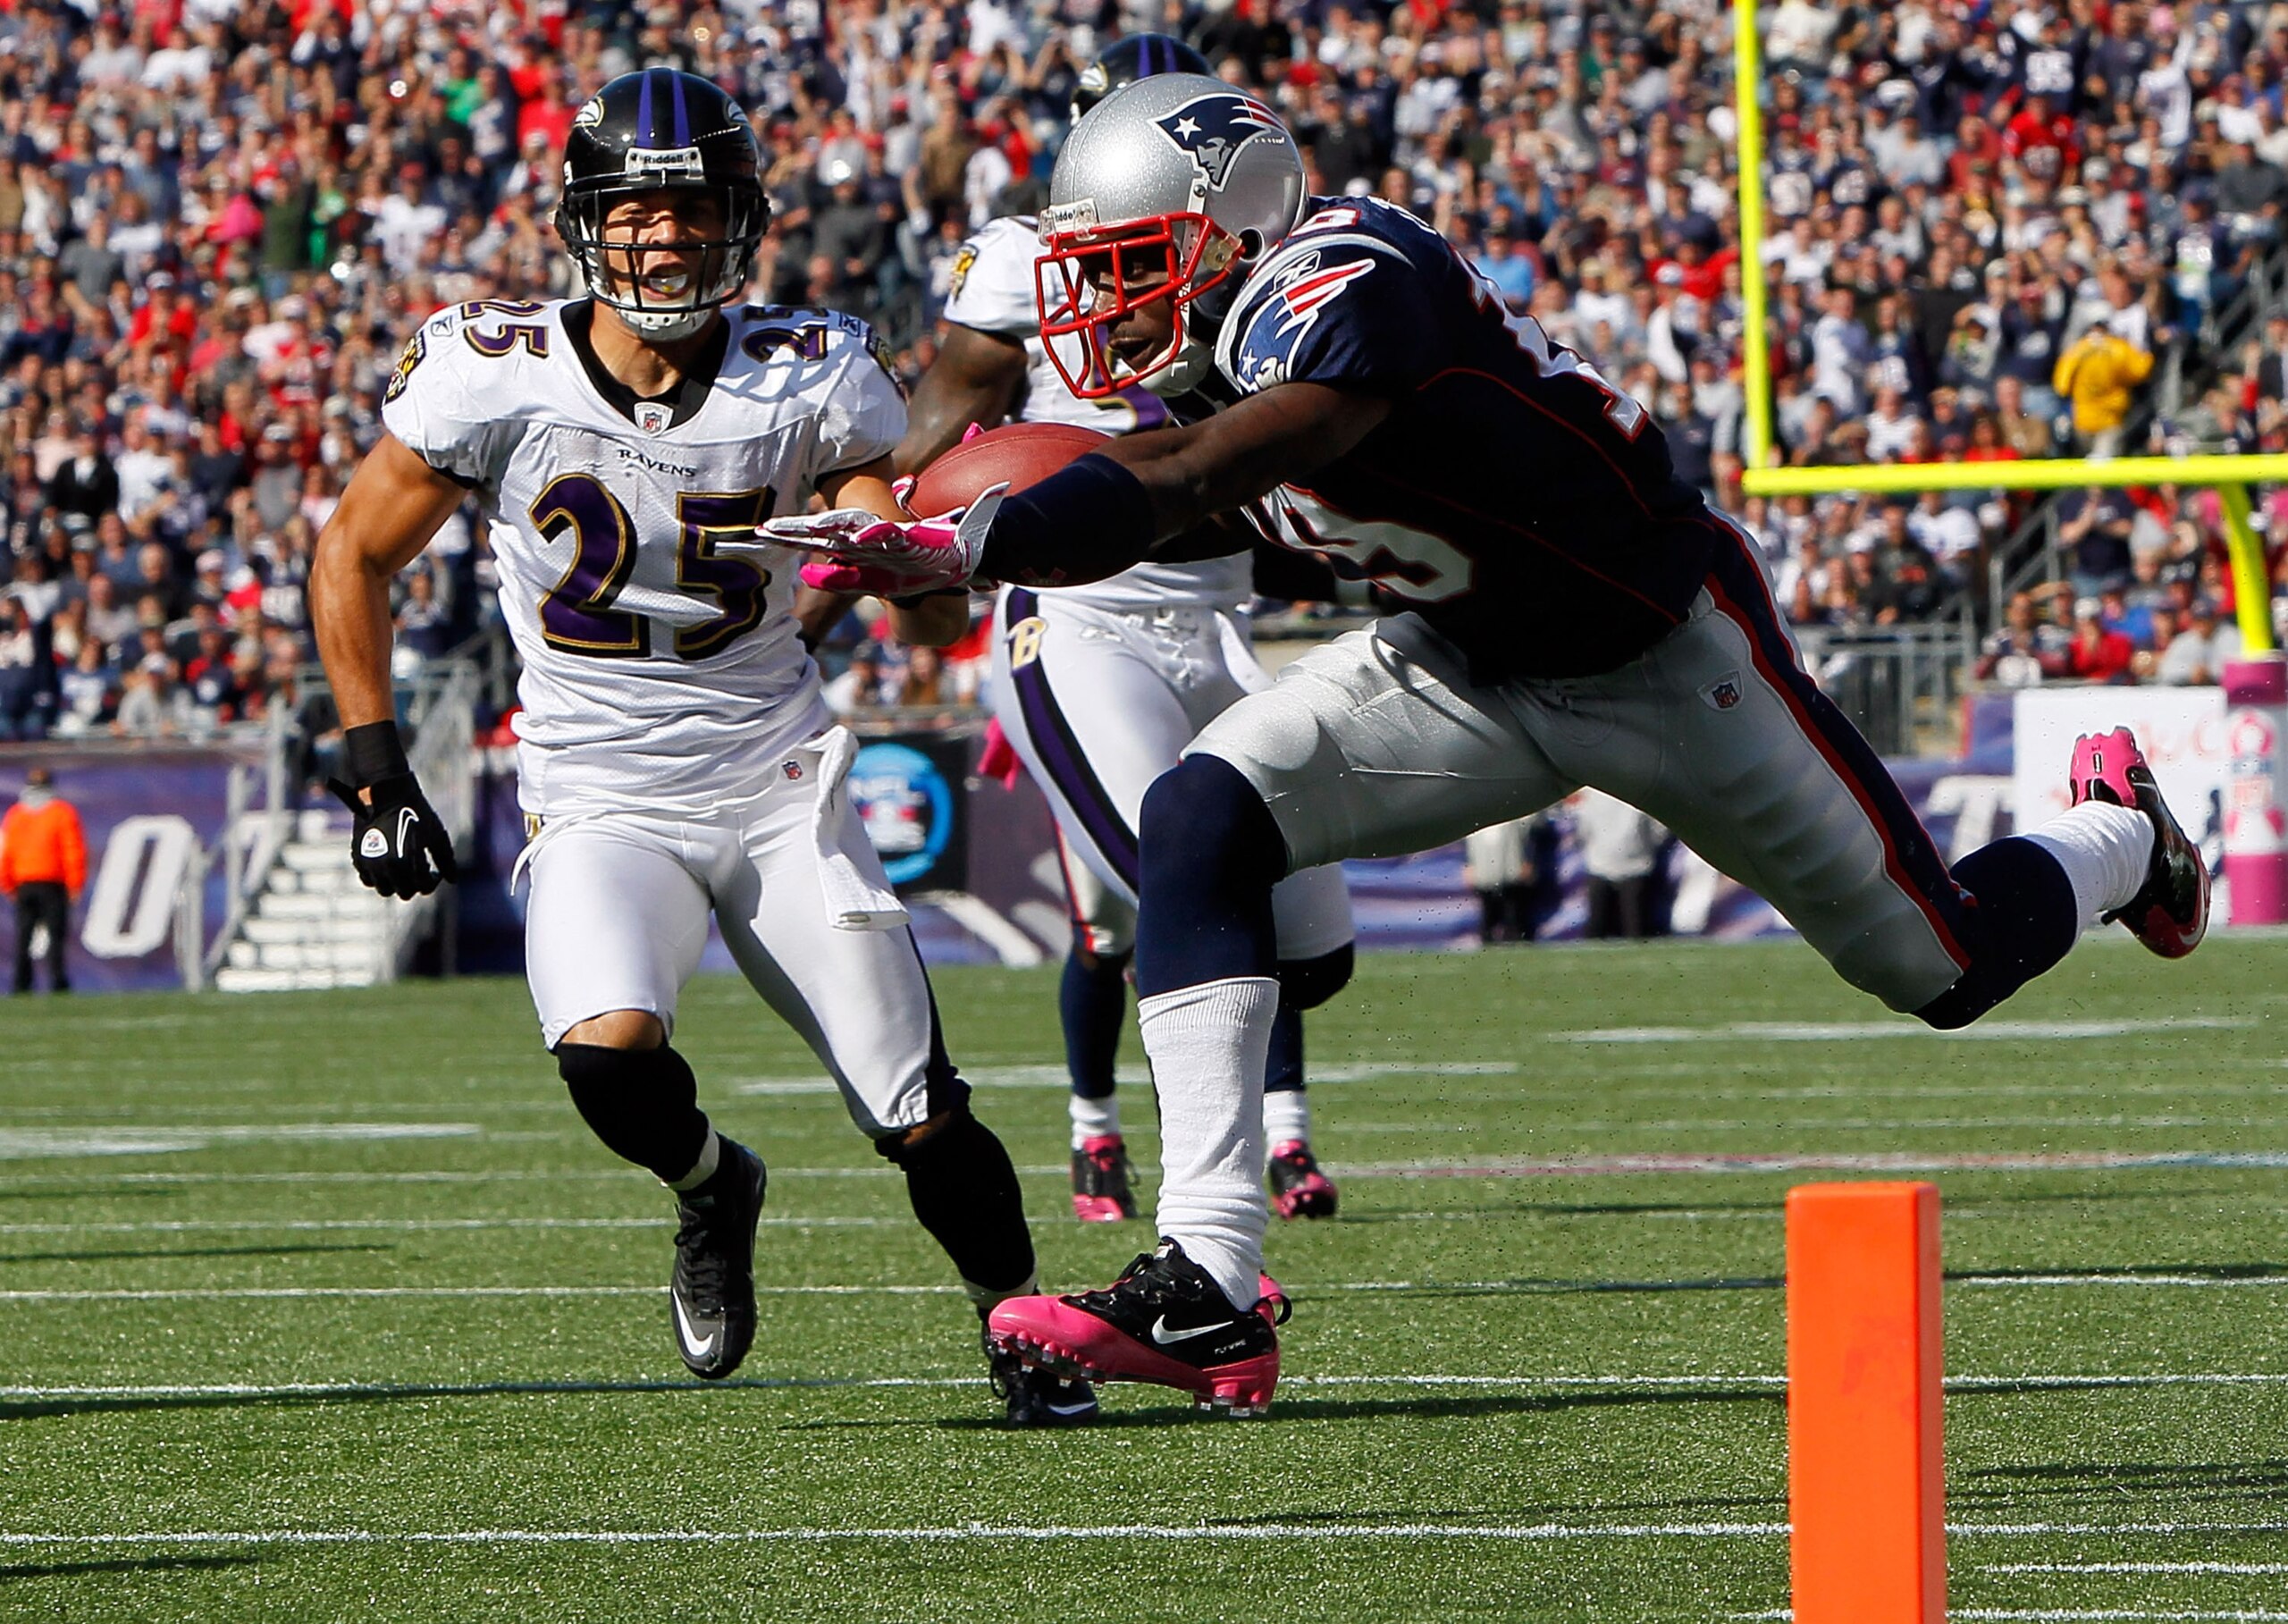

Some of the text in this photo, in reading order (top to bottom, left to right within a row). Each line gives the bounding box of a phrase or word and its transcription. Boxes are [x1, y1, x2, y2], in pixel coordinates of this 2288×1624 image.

[644, 154, 685, 164] Riddell
[617, 449, 699, 477] RAVENS
[529, 473, 777, 660] 25
